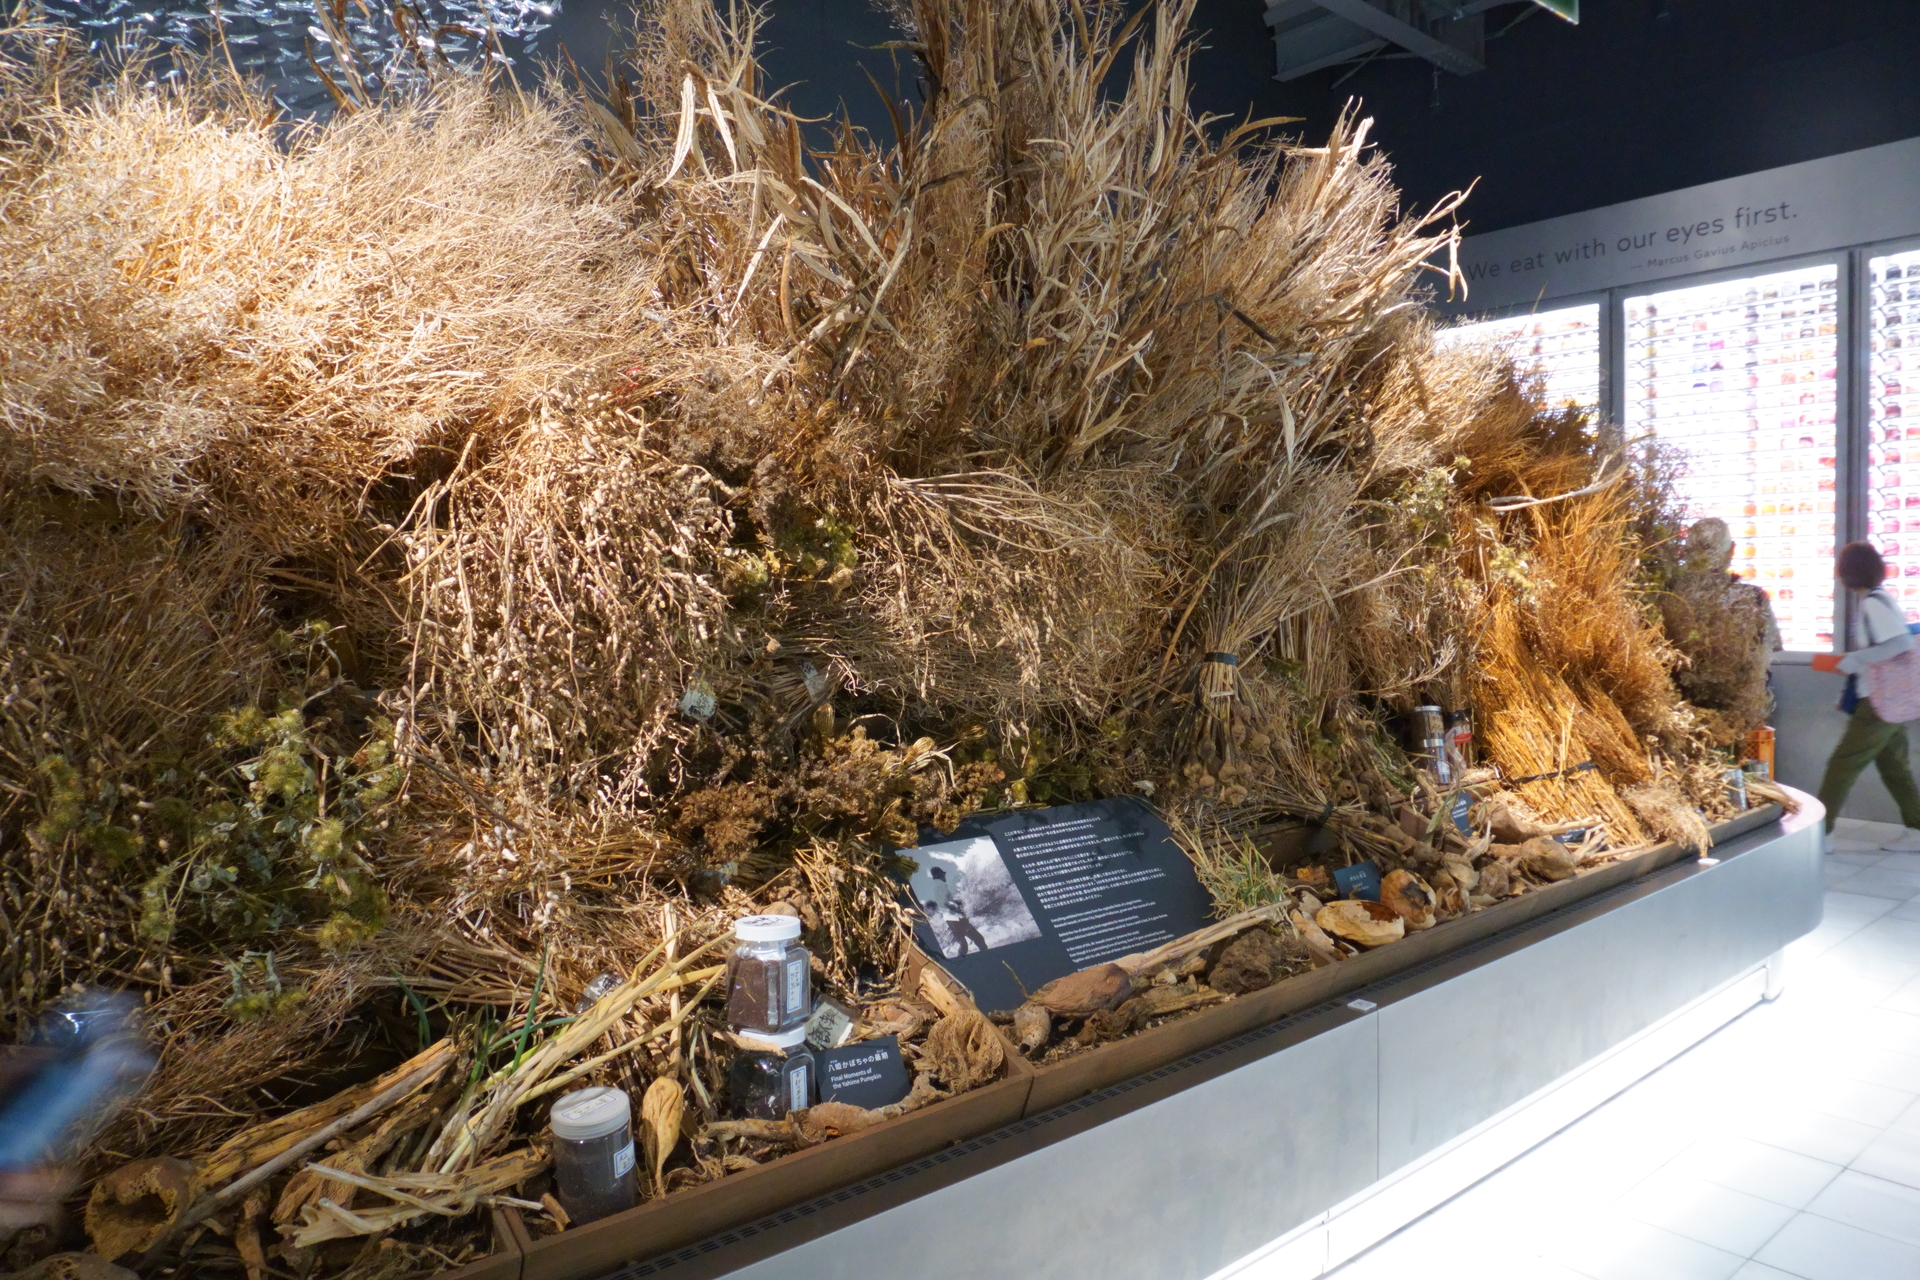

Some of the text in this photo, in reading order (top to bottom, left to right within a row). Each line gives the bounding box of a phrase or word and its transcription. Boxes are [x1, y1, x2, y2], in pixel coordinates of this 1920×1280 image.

[1466, 202, 1798, 281] We eat with our eyes first.
[1647, 254, 1690, 268] Marcus
[1694, 245, 1736, 260] Gavius
[1740, 234, 1790, 251] Apicius
[831, 1074, 843, 1082] Final
[843, 1070, 867, 1079] Moments
[860, 1073, 882, 1083] Pumpkin
